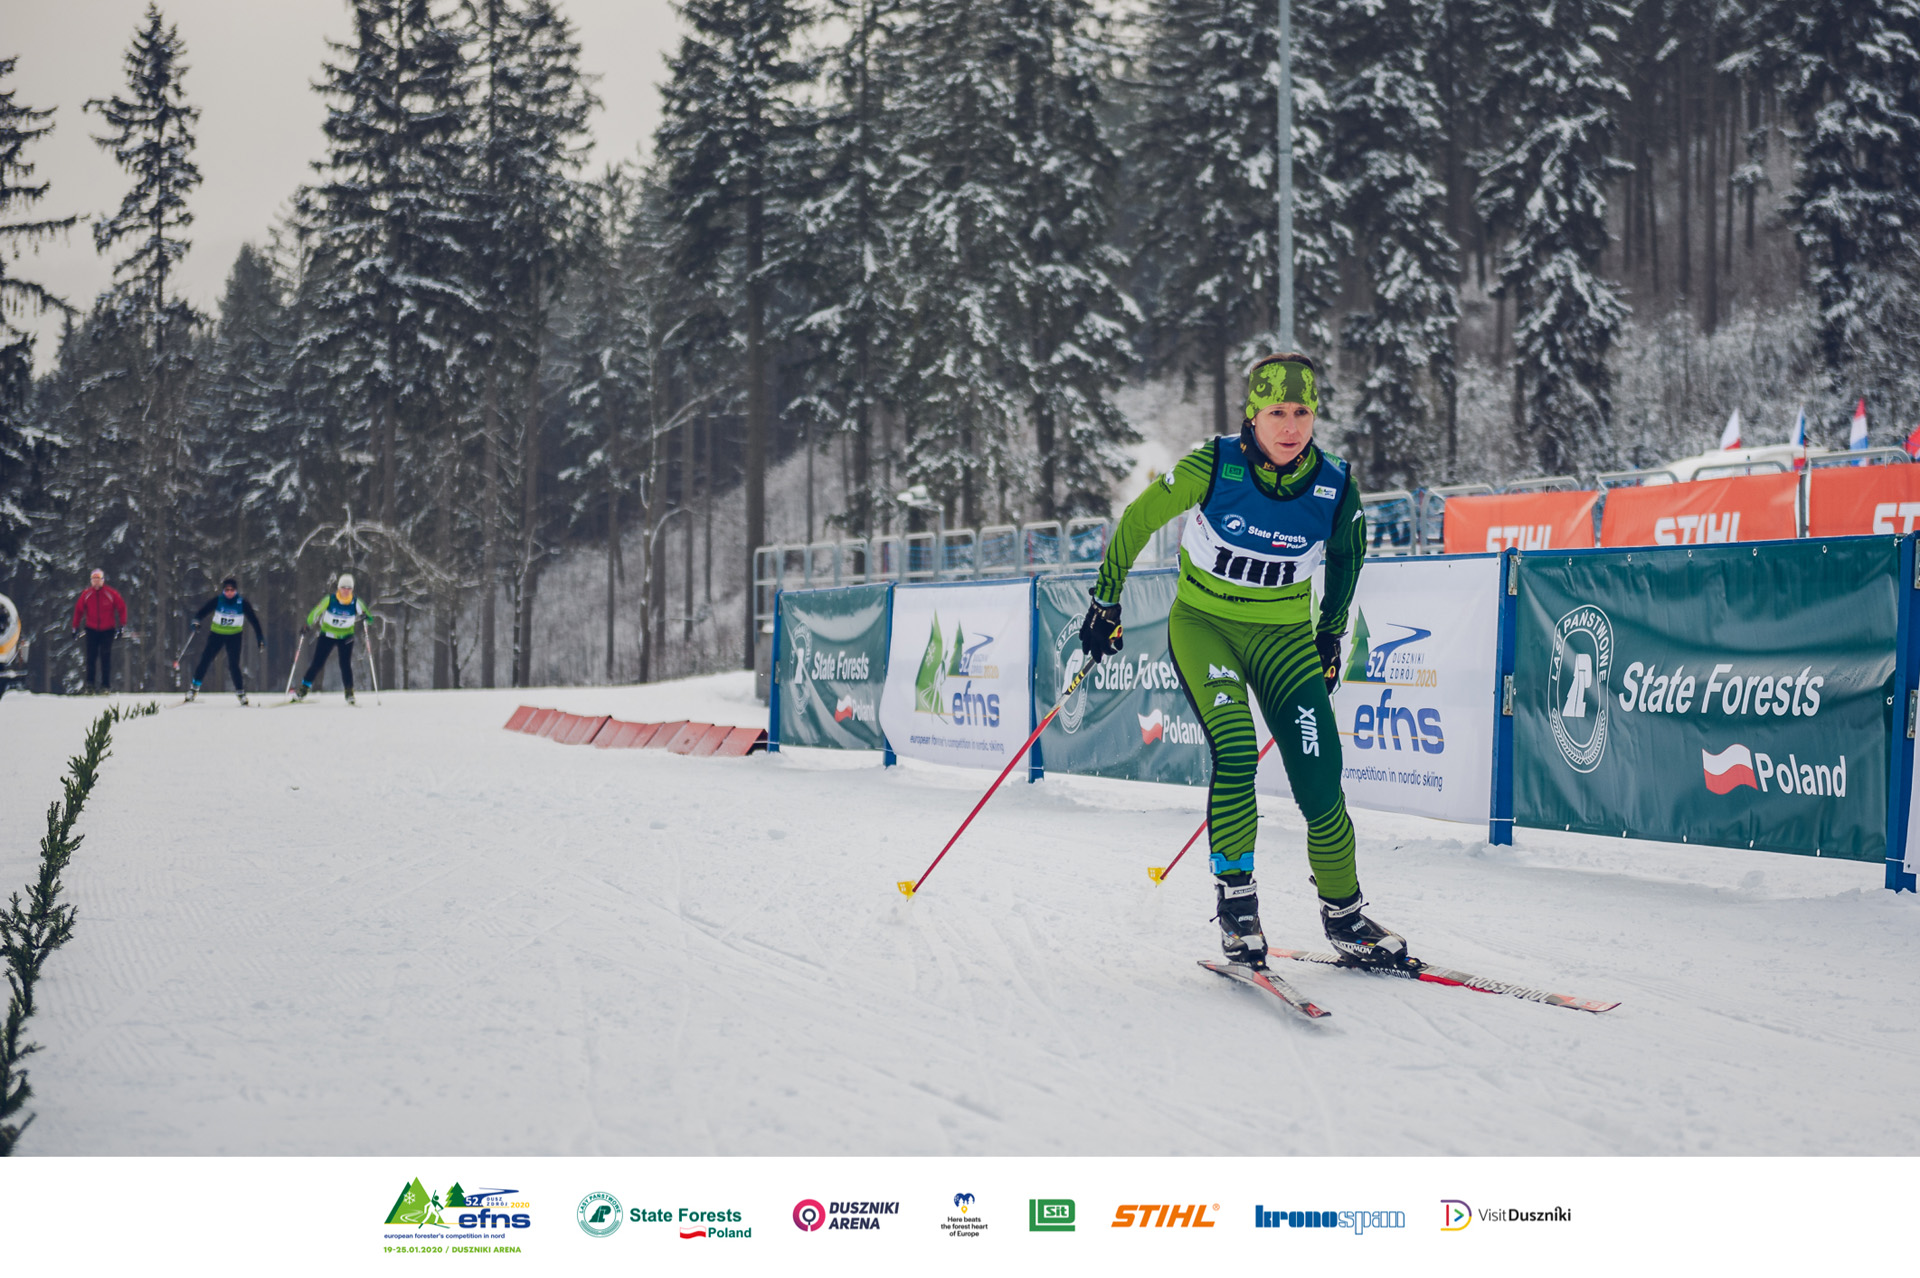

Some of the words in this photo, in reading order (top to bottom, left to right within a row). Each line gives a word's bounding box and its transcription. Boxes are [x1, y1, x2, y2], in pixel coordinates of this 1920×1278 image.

[1248, 525, 1272, 539] State
[1273, 531, 1307, 544] Forests
[1366, 651, 1385, 678] 52.
[1392, 652, 1425, 664] DUSZNIKI
[1551, 628, 1563, 681] LASY
[1564, 609, 1610, 683] PAŃSTWOWE
[811, 651, 836, 680] State
[836, 650, 869, 680] Forests
[1094, 654, 1133, 690] State
[1133, 653, 1180, 690] Fores
[1390, 665, 1415, 680] ZDRÓJ
[1415, 668, 1437, 688] 2020
[952, 680, 1000, 728] efns
[1618, 661, 1696, 715] State
[1701, 663, 1824, 717] Forests
[1294, 705, 1320, 758] swix
[1353, 688, 1444, 754] efns
[1388, 767, 1397, 783] in
[1398, 769, 1421, 786] nordic
[1422, 771, 1443, 792] skiing
[1755, 752, 1847, 798] Poland
[1463, 975, 1551, 1003] ROSSIGNOL
